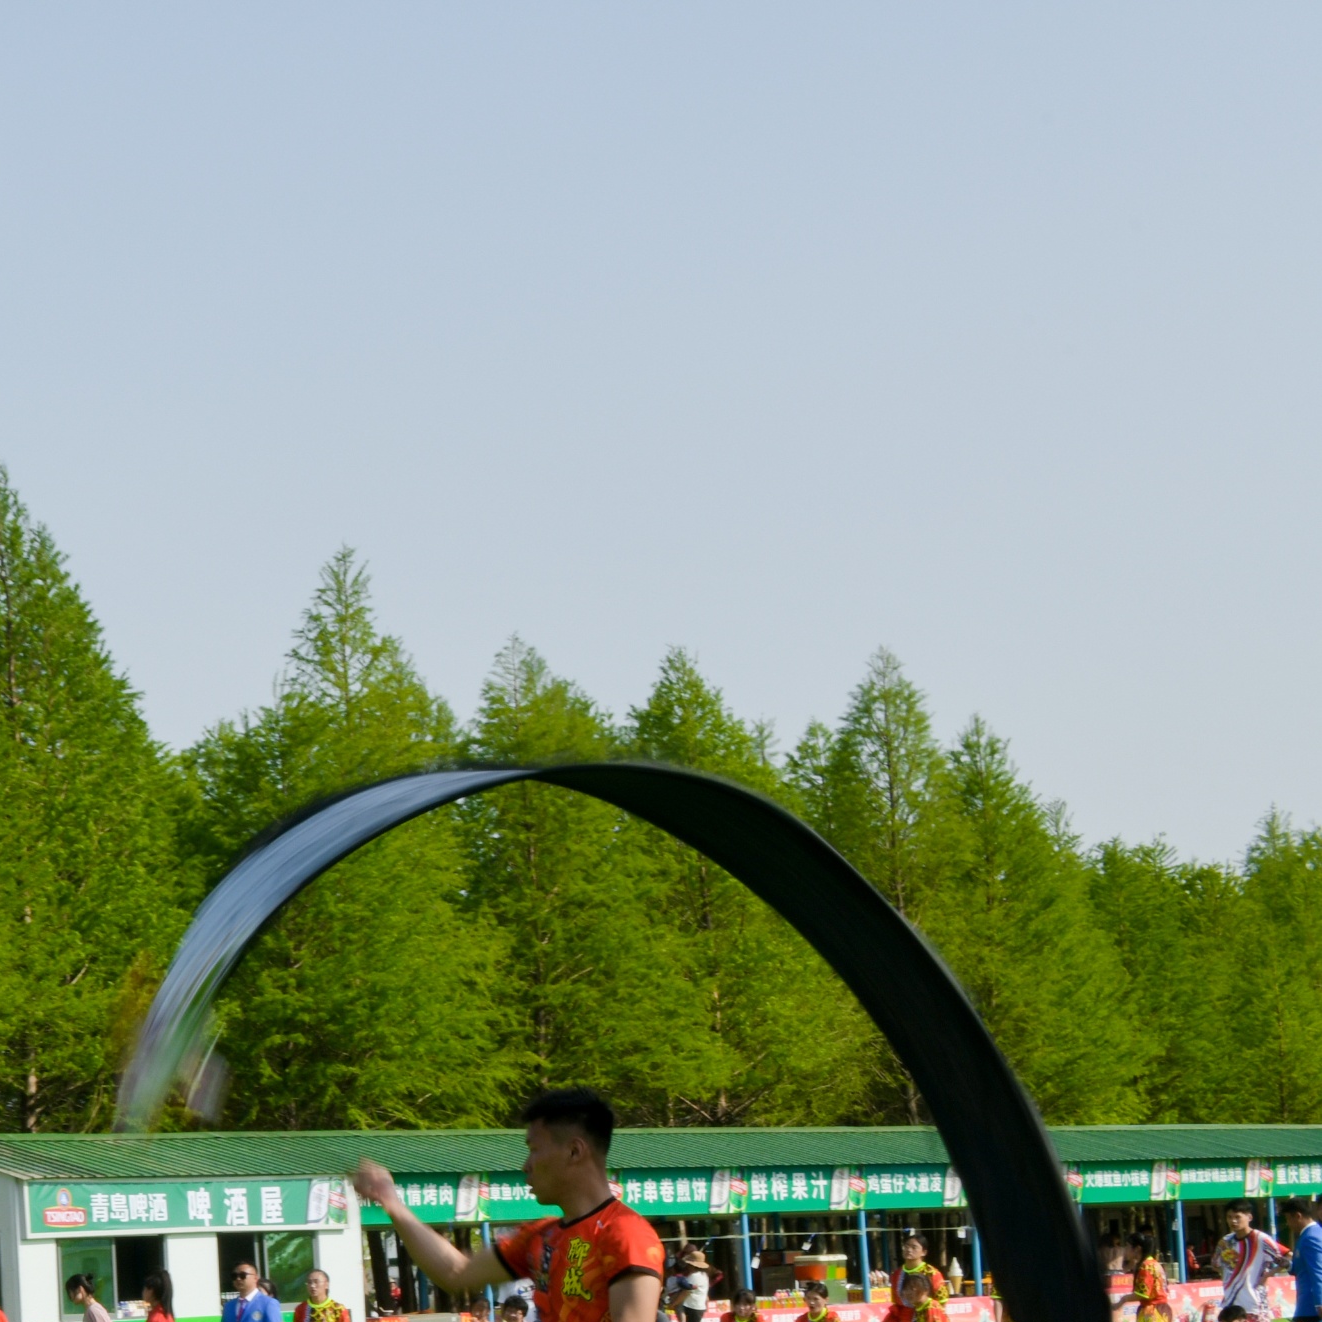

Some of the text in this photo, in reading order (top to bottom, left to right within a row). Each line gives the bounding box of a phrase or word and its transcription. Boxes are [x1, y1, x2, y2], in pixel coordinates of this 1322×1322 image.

[626, 1178, 707, 1203] 炸串卷煎饼
[751, 1172, 828, 1200] 鲜榨果汁
[867, 1173, 942, 1194] 鸡蛋仔冰激凌
[44, 1210, 85, 1223] TSINGTAO
[89, 1186, 284, 1226] 青岛啤酒 啤酒屋
